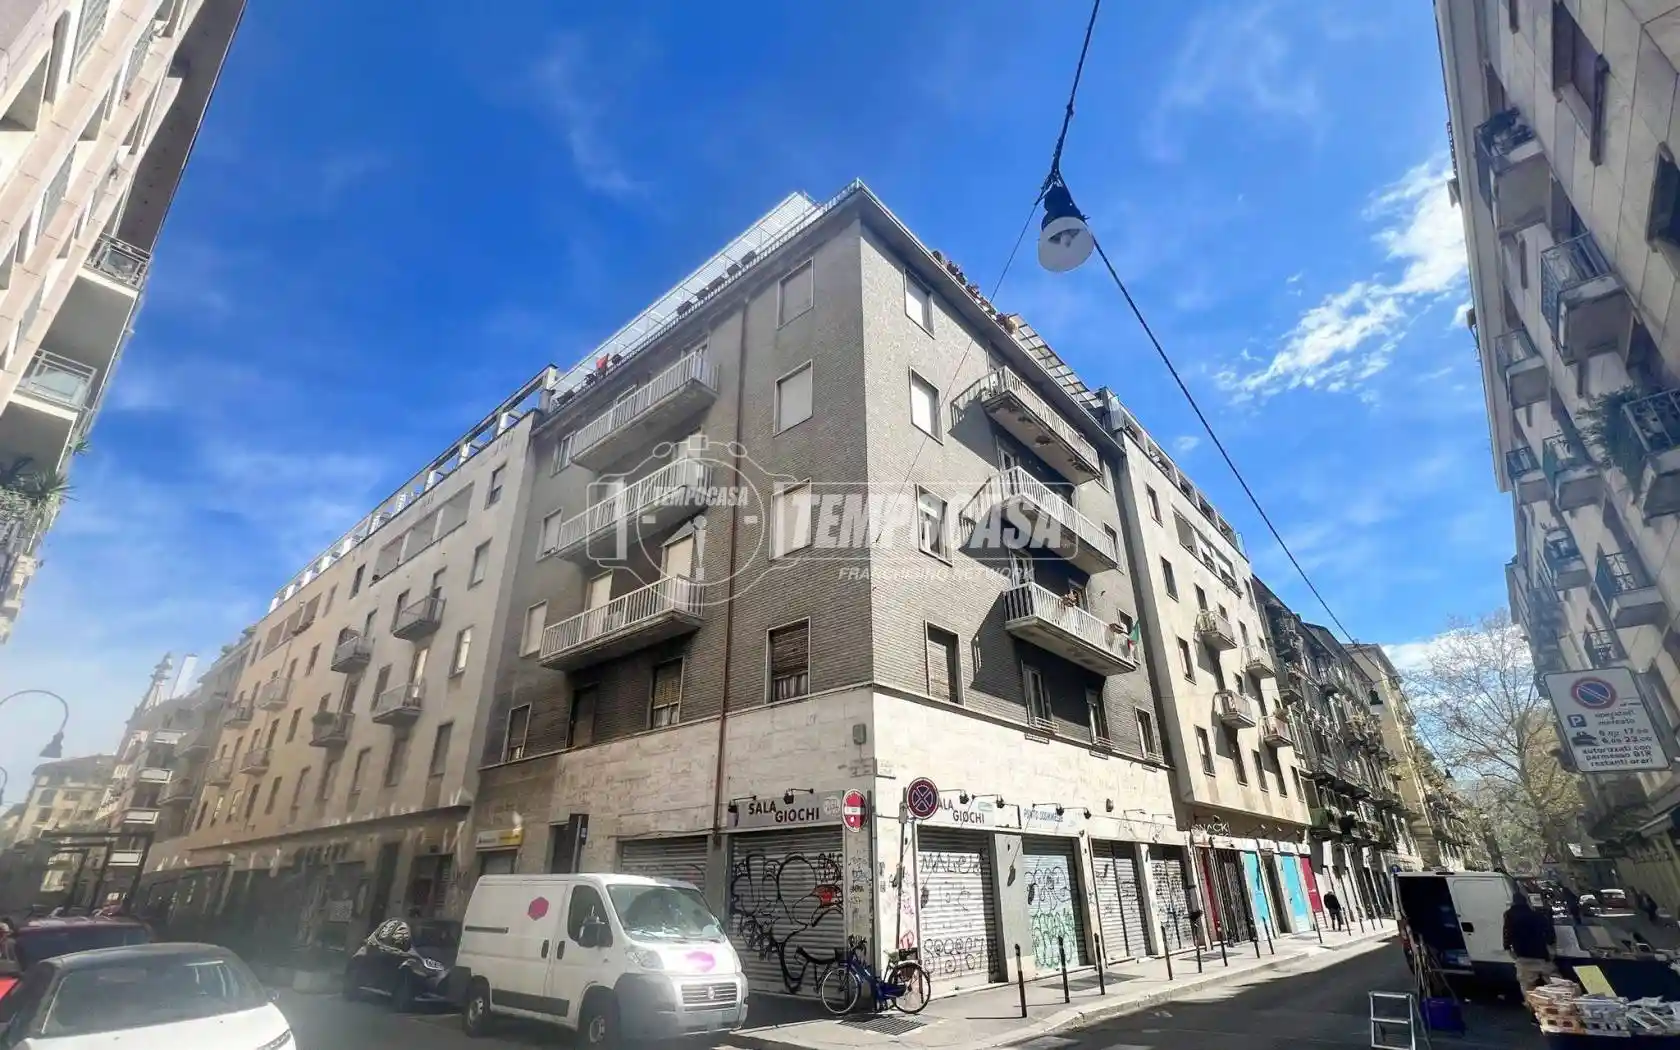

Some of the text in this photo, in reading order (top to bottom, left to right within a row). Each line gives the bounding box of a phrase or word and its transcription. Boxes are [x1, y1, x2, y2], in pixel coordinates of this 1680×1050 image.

[748, 800, 777, 816] SALA
[938, 798, 954, 810] ALA
[775, 806, 820, 823] GIOCHI
[952, 809, 985, 824] GIOCHI
